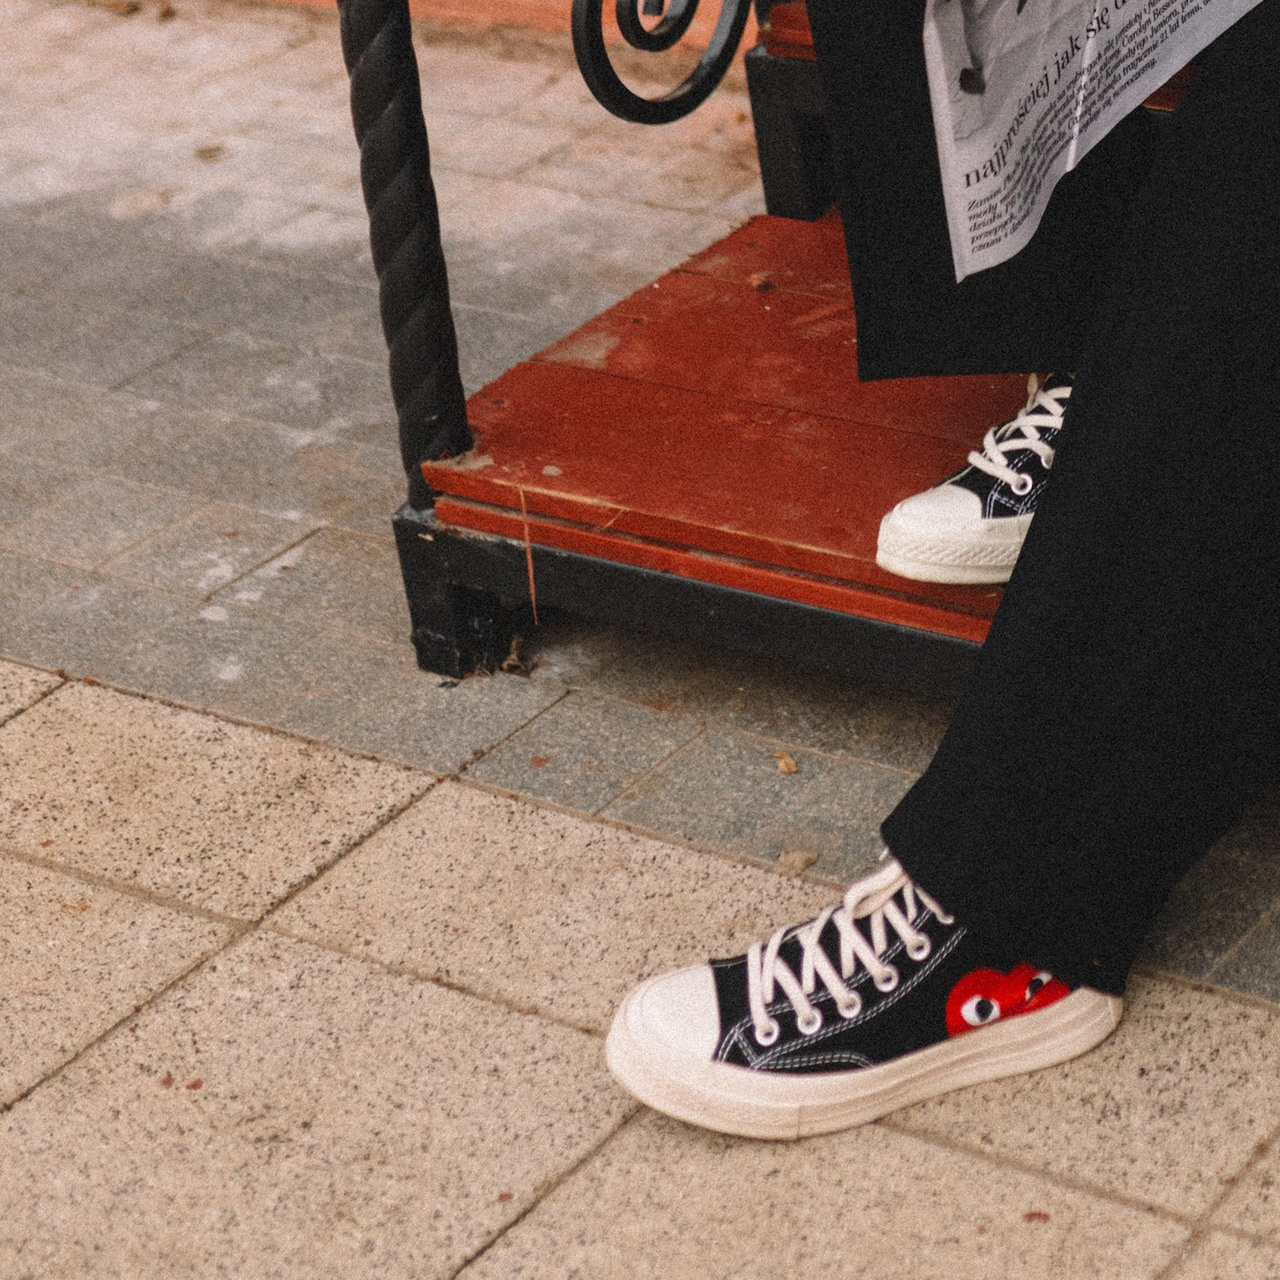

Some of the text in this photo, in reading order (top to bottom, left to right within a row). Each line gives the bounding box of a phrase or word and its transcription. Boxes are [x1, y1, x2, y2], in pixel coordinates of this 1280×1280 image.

[965, 65, 1052, 187] najprościej
[1055, 35, 1081, 85] jak
[1086, 7, 1110, 40] się
[969, 203, 997, 220] mody
[1120, 18, 1152, 47] Carolyn
[1160, 30, 1168, 44] 21
[1169, 19, 1179, 34] lat
